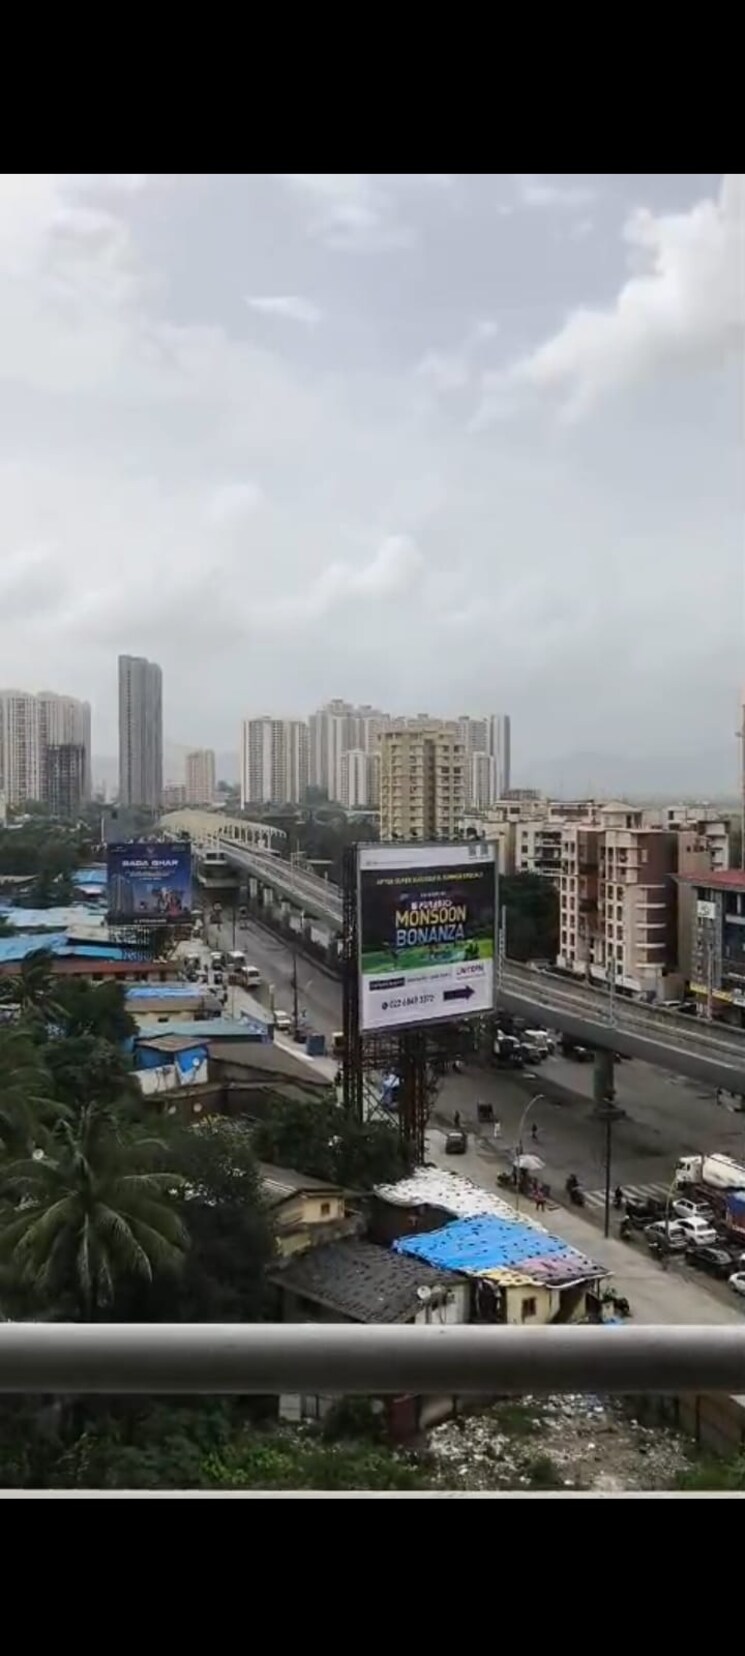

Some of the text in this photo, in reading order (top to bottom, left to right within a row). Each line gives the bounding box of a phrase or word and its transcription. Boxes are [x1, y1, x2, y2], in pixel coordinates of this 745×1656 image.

[395, 905, 466, 928] MONSOON
[397, 924, 465, 947] BONANZA
[390, 999, 402, 1009] 022
